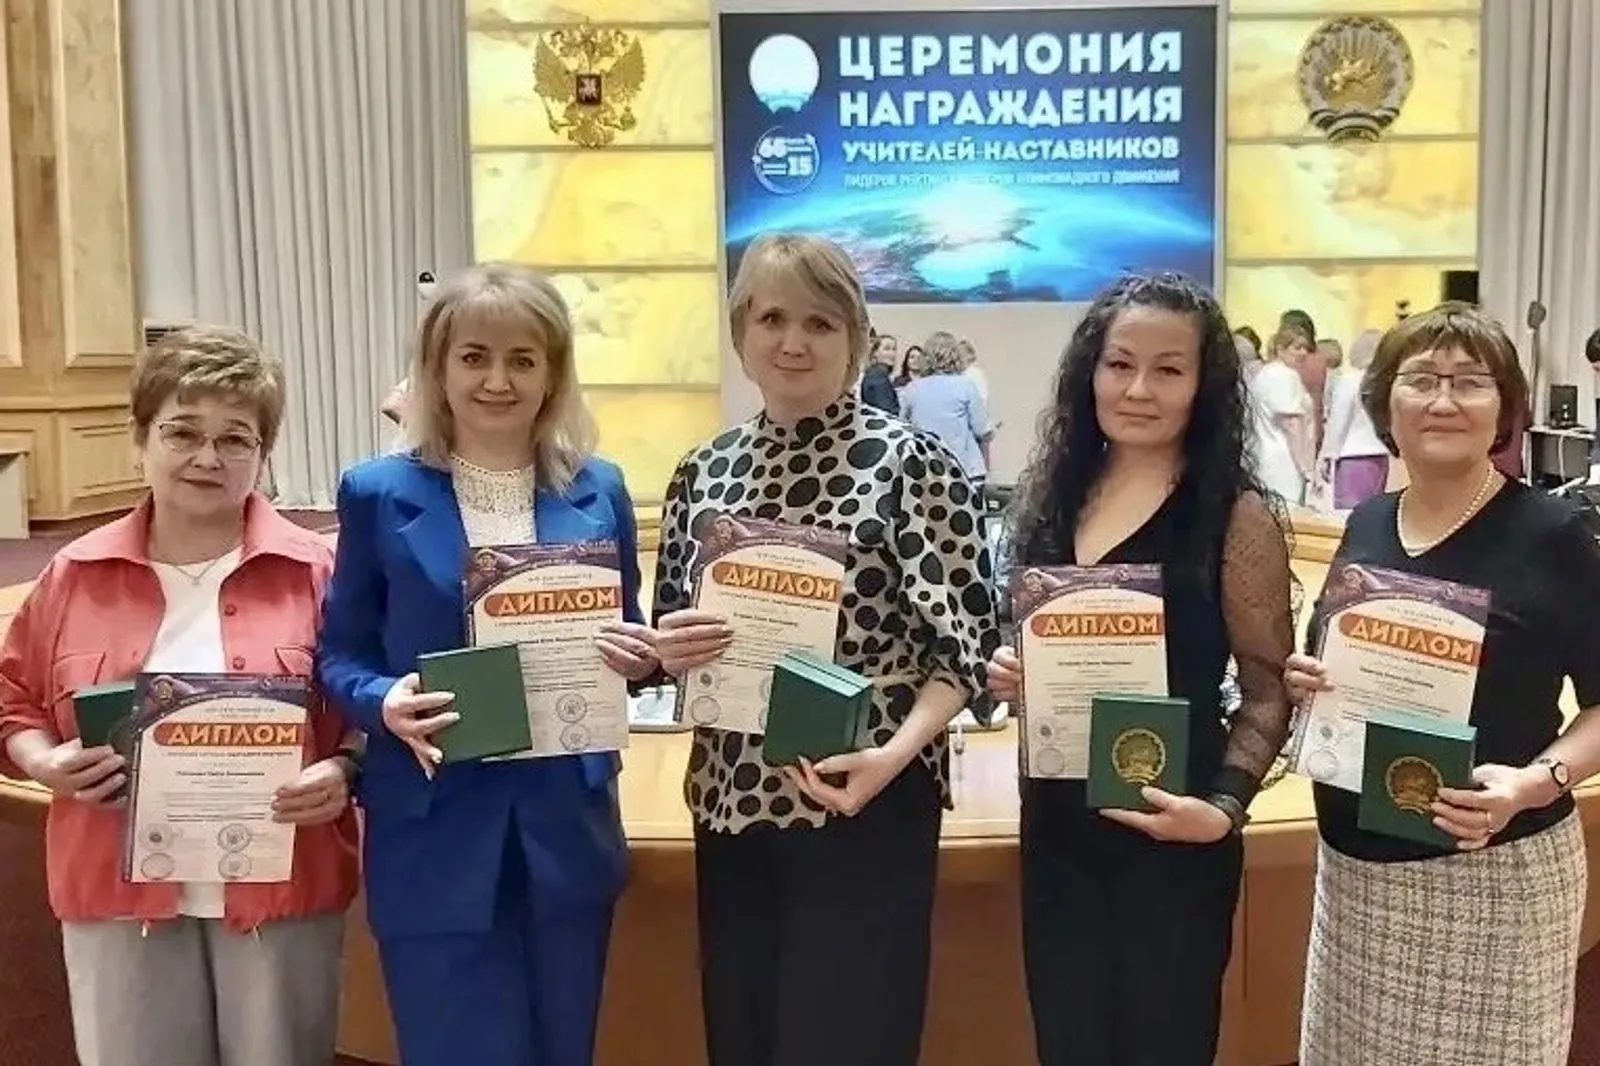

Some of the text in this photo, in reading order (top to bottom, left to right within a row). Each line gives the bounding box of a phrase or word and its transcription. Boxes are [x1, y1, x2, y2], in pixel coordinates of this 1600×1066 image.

[838, 31, 1182, 80] ЦЕРЕМОНИЯ
[839, 86, 1182, 128] НАГРАЖДЕНИЯ
[726, 566, 837, 600] ДИПЛОМ
[498, 587, 616, 615] ДИПЛОМ
[1044, 615, 1158, 636] ДИПЛОМ
[1350, 618, 1475, 664] ДИПЛОМ
[167, 724, 297, 745] ДИПЛОМ
